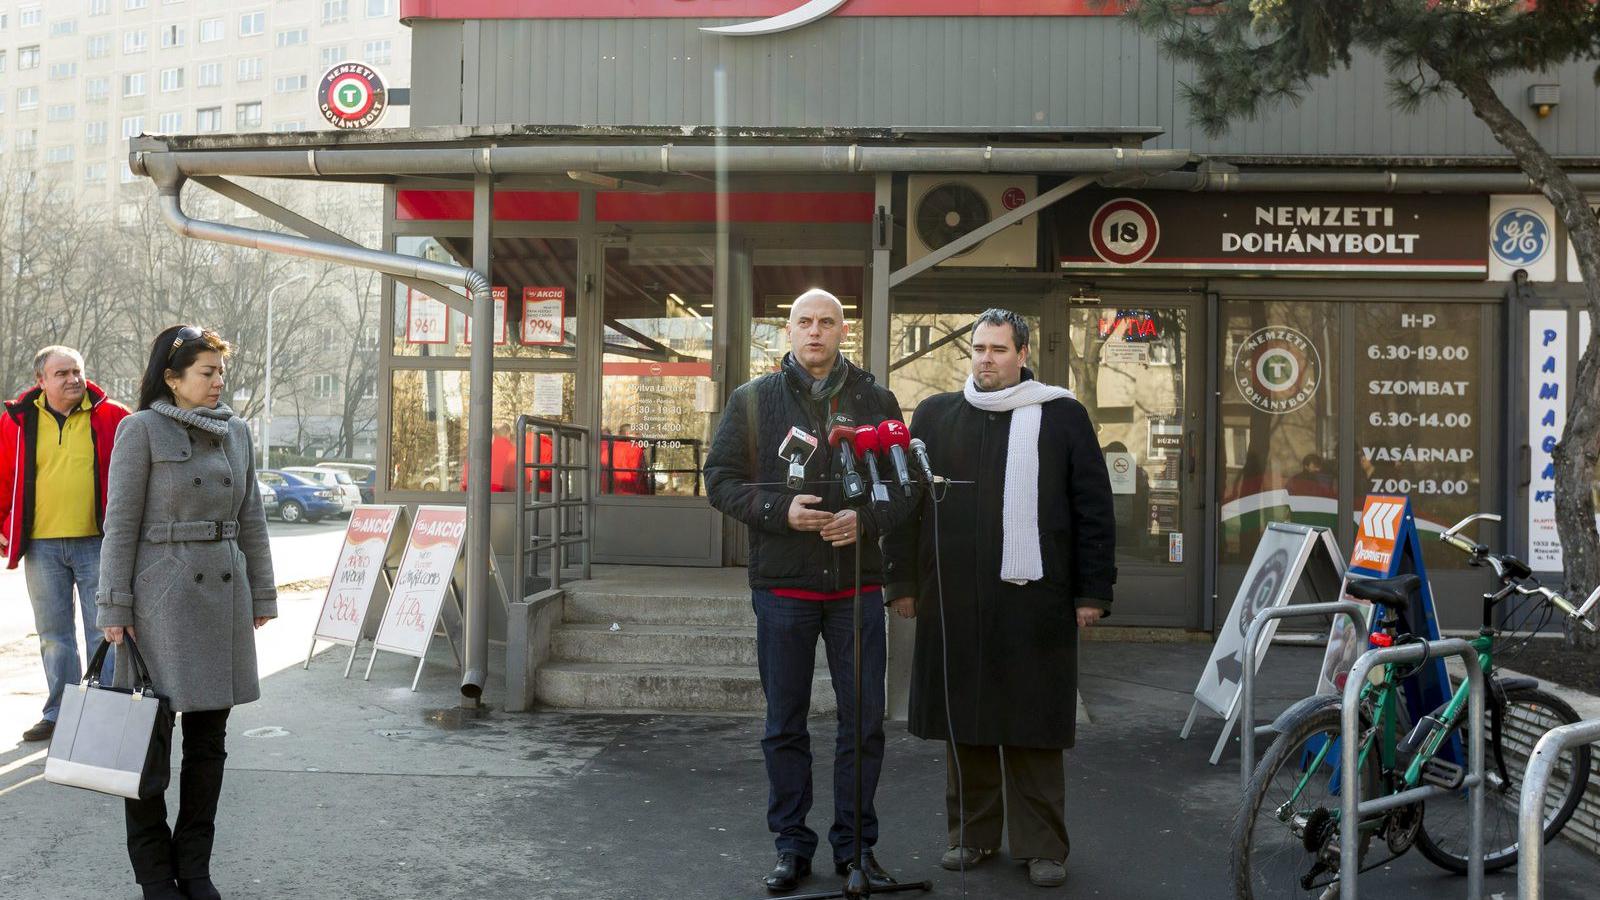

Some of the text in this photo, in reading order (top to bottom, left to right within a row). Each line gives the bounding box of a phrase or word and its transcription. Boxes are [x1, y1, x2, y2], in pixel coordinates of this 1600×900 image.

[327, 65, 375, 81] NEMZETI
[343, 90, 357, 103] T
[321, 101, 382, 128] DOHÁNYBOLT
[1255, 206, 1393, 227] NEMZETI
[1109, 222, 1139, 243] 18
[1221, 227, 1420, 254] DOHÁNYBOLT
[1401, 313, 1436, 328] H-P
[1248, 330, 1308, 351] NEMZETI
[1367, 344, 1470, 361] 6.30-19.00
[1268, 362, 1286, 378] T
[1240, 377, 1316, 410] DOHÁNYBOLT
[1368, 380, 1470, 396] SZOMBAT
[1368, 411, 1472, 428] 6.30-14.00
[630, 440, 650, 449] 7:00
[657, 440, 681, 449] 13:00
[1362, 444, 1474, 463] VASÁRNAP
[1371, 478, 1469, 495] 7.00-13.00
[362, 512, 394, 533] AKCIÓ
